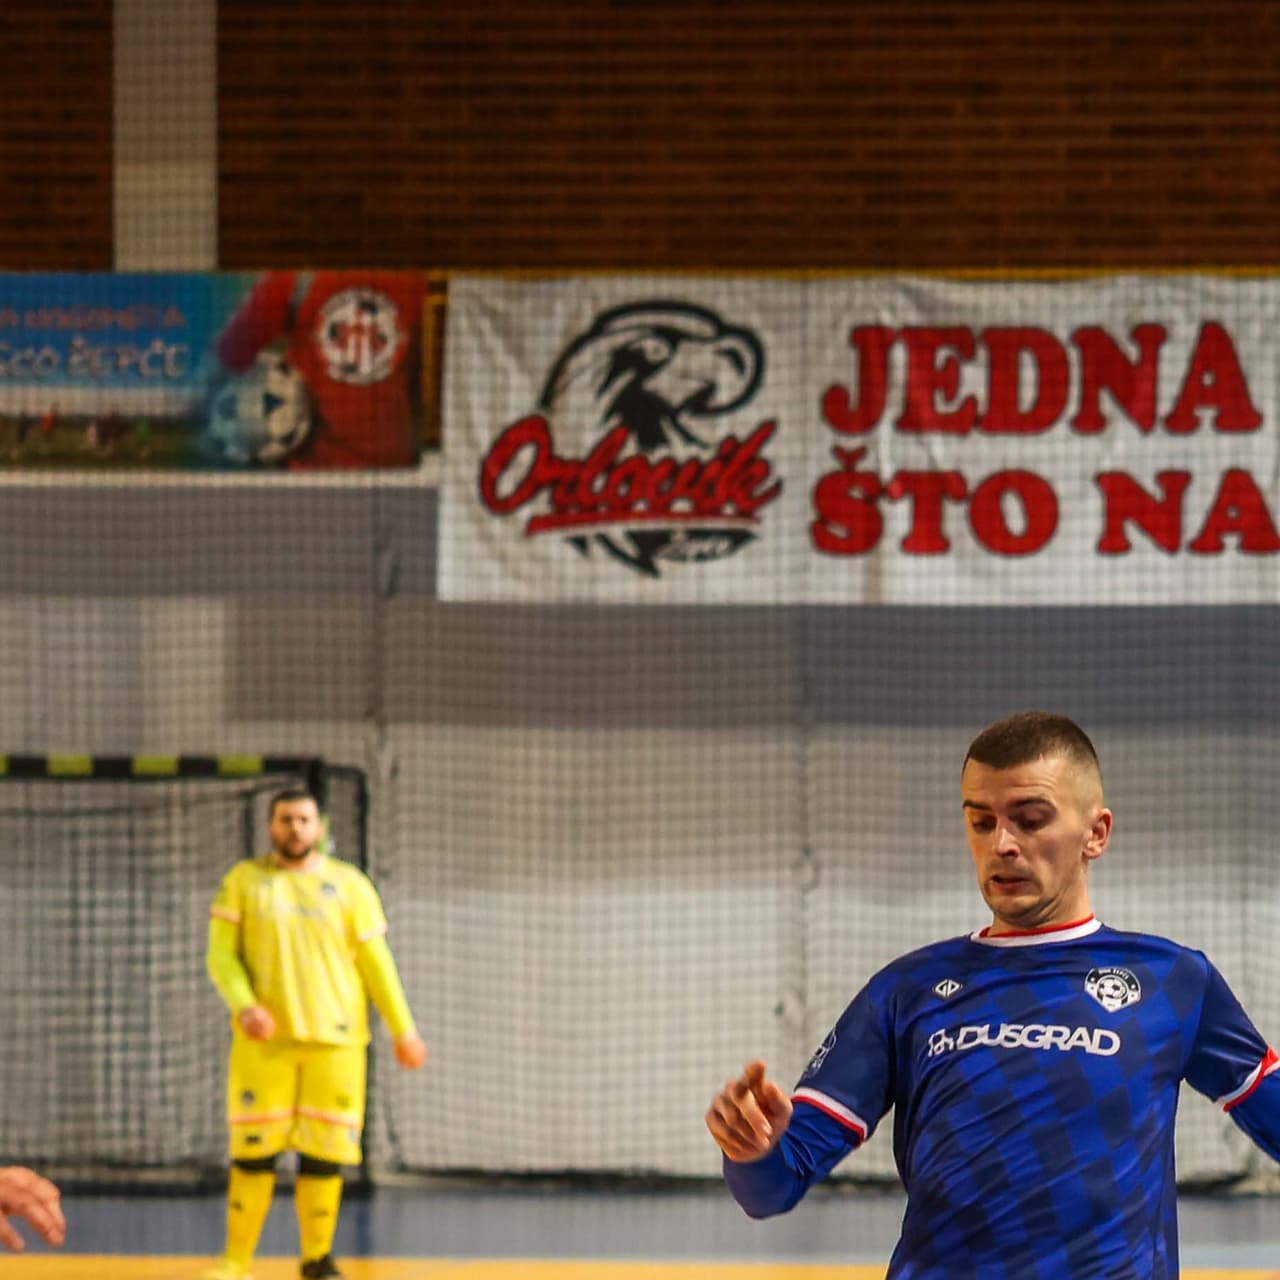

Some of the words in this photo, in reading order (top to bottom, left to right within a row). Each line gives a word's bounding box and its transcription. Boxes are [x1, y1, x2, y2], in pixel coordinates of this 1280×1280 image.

[821, 321, 1263, 434] JEDNA
[480, 411, 784, 517] Orlovik
[810, 445, 1060, 557] ŠTO
[956, 1023, 1121, 1057] DUSGRAD
